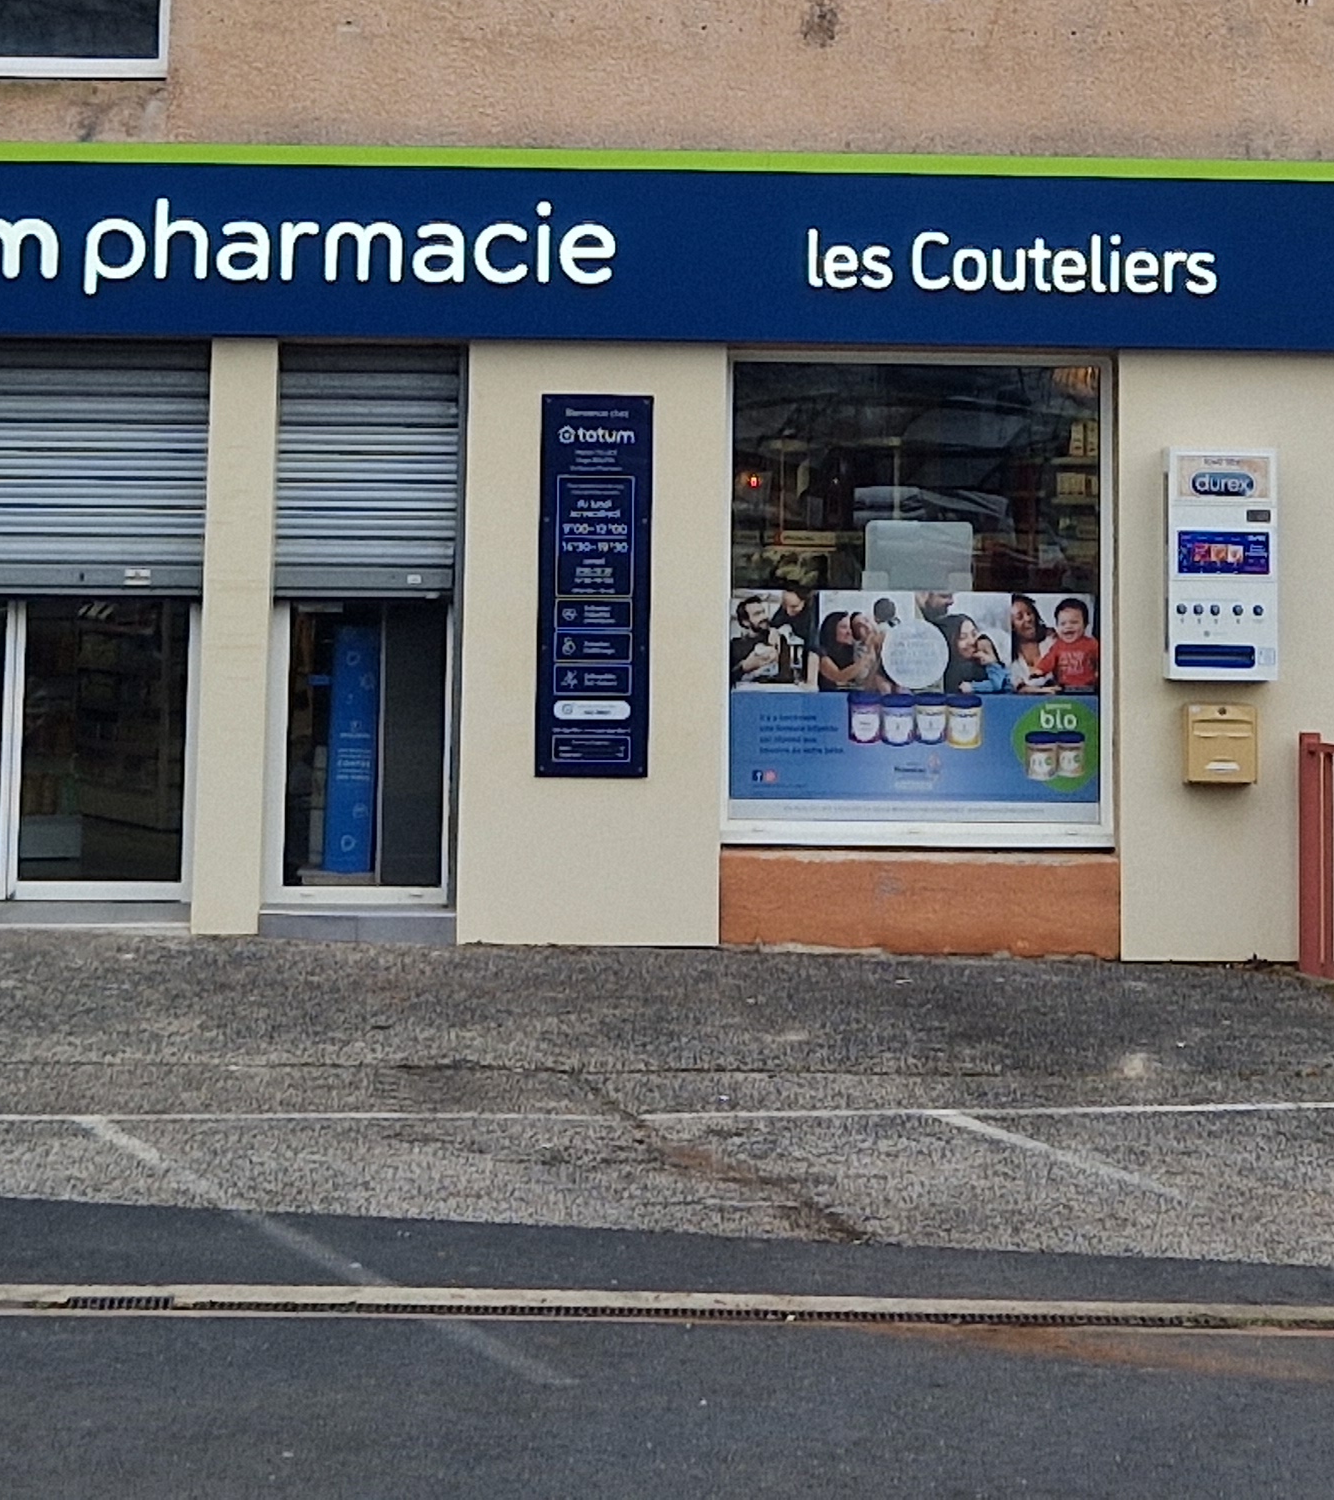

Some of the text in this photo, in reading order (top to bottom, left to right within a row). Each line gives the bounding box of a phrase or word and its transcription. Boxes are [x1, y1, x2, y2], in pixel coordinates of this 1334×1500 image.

[84, 197, 616, 295] pharmacie
[807, 228, 1217, 295] les Couteliers
[577, 426, 635, 444] totum
[1195, 474, 1250, 492] durex
